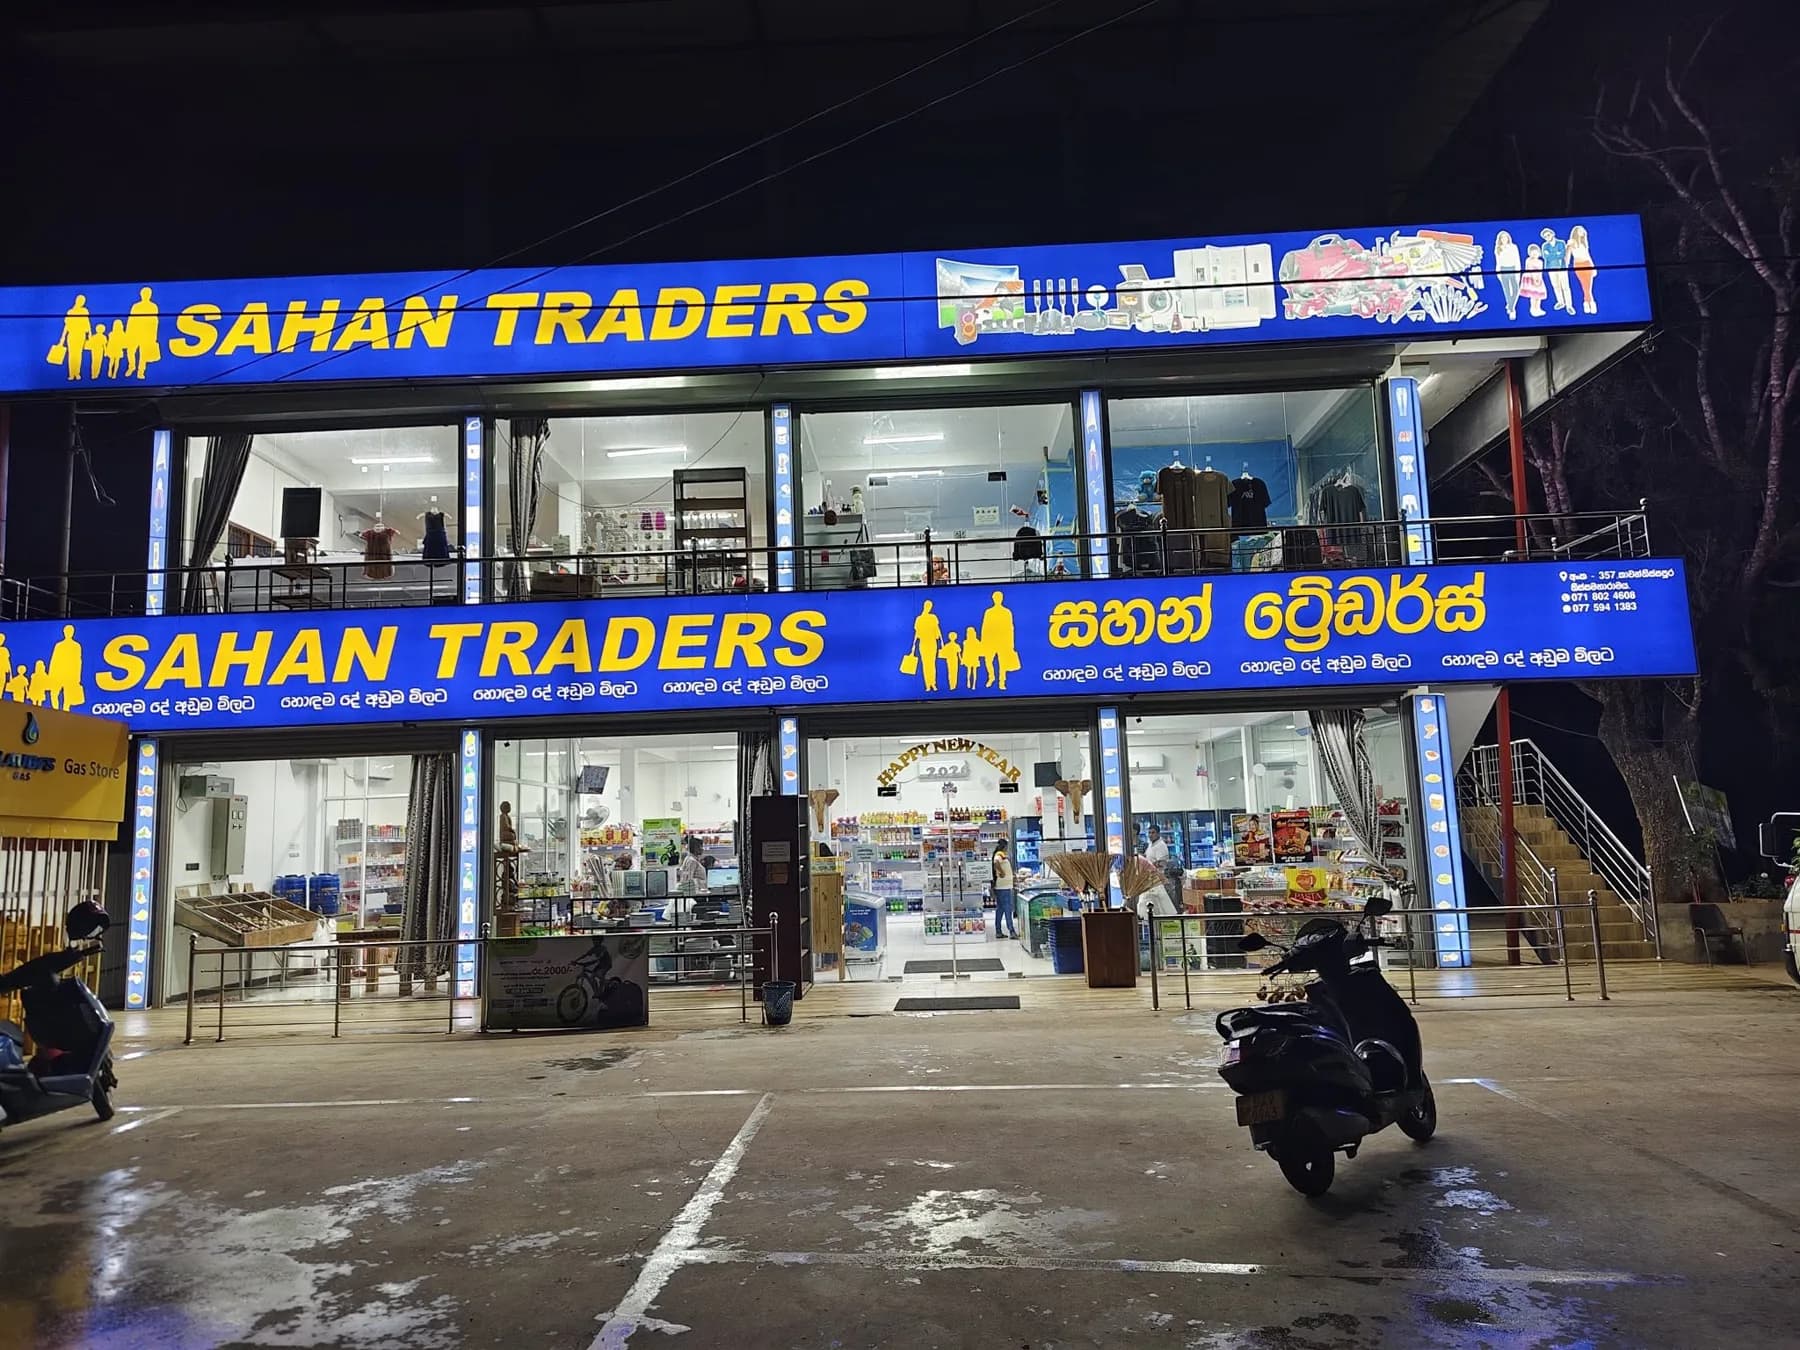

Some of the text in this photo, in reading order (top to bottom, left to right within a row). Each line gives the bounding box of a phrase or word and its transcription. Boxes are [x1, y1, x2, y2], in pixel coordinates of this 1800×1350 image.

[168, 279, 869, 358] SAHAN TRADERS
[1570, 593, 1589, 602] 071
[1572, 604, 1590, 613] 077
[1048, 581, 1214, 649] සහන්
[95, 610, 827, 692] SAHAN TRADERS
[1529, 649, 1571, 668] අඩුම
[1575, 647, 1615, 666] මිලට
[1128, 662, 1168, 682] අඩුම
[1172, 660, 1211, 679] මිලට
[1326, 655, 1367, 674] අඩුම
[1371, 654, 1412, 672] මිලට
[556, 682, 596, 702] අඩුම
[599, 680, 640, 699] මිලට
[747, 676, 786, 695] අඩුම
[790, 674, 829, 692] මිලට
[174, 697, 213, 716] අඩුම
[218, 694, 256, 713] මිලට
[365, 689, 405, 710] අඩුම
[409, 687, 448, 705] මිලට
[64, 758, 120, 779] Gas Store
[876, 737, 1022, 786] HAPPY NEW YEAR
[1293, 891, 1322, 900] PASTA
